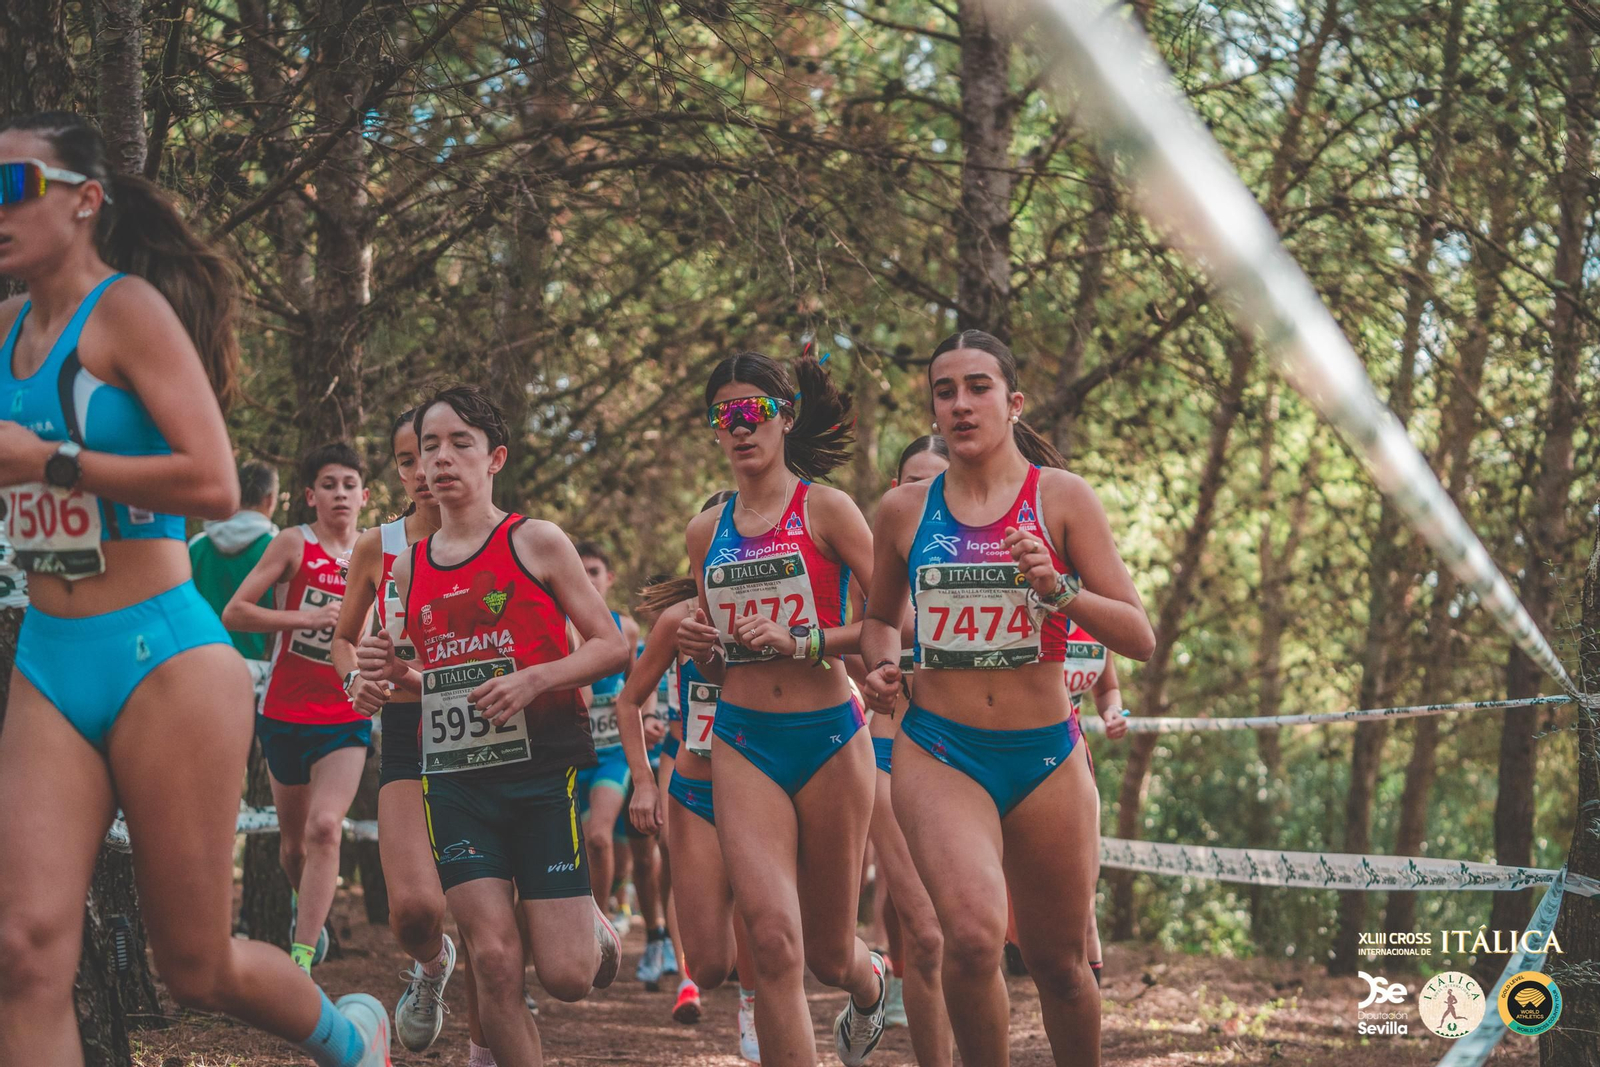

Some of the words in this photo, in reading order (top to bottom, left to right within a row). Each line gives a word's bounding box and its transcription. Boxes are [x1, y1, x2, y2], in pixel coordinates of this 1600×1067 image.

[745, 542, 800, 559] lapalma
[730, 563, 778, 579] ITÁLICA
[949, 566, 1007, 582] ITÁLICA
[928, 605, 1032, 642] 7474
[439, 668, 486, 685] ITÁLICA
[697, 714, 714, 742] 7
